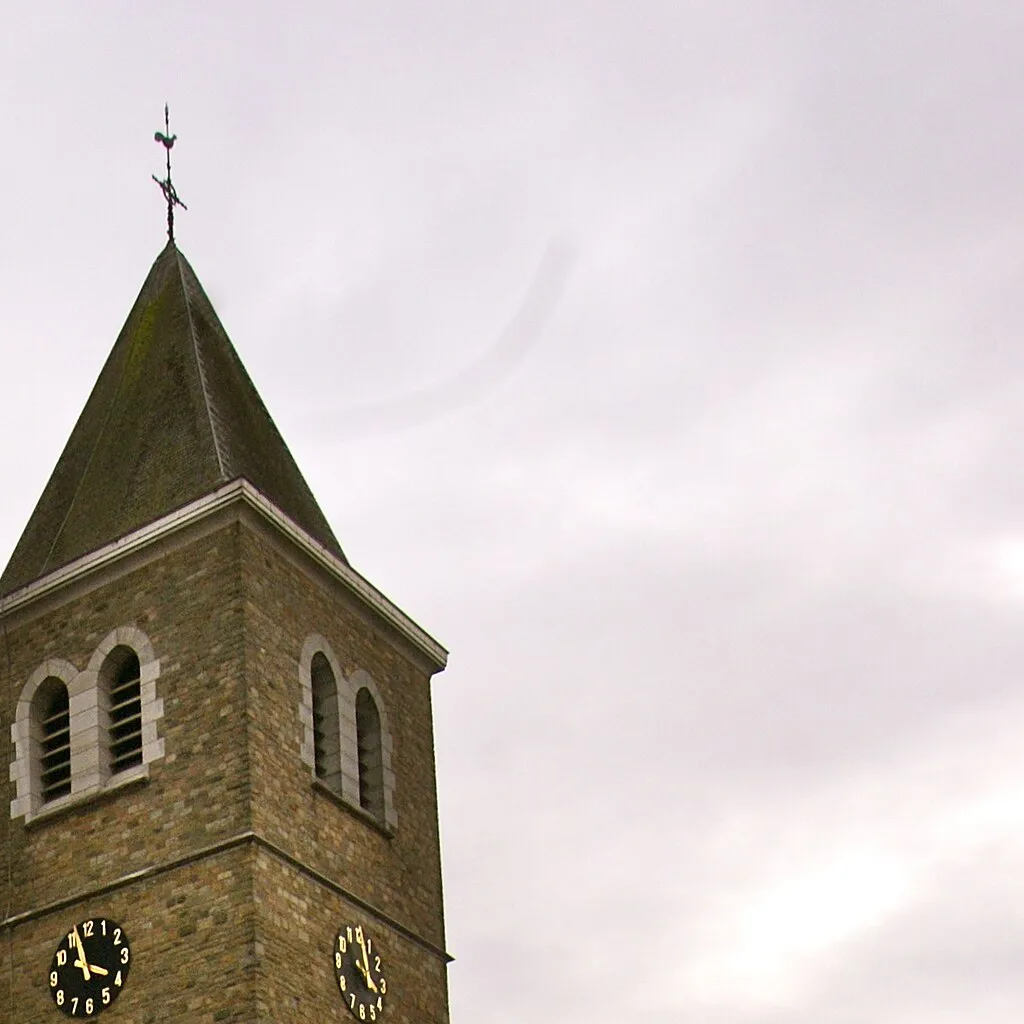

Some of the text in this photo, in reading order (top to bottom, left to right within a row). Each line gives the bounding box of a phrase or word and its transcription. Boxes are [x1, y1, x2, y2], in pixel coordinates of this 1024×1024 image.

[83, 920, 94, 937] 12
[101, 920, 106, 936] 1
[113, 928, 121, 946] 2
[339, 936, 346, 953] 10
[367, 939, 372, 954] 1
[56, 950, 67, 966] 10
[120, 948, 128, 964] 3
[375, 956, 381, 972] 2
[50, 972, 58, 987] 9
[114, 970, 122, 986] 4
[380, 978, 386, 994] 3
[56, 990, 64, 1005] 8
[102, 988, 110, 1004] 5
[350, 993, 356, 1008] 7
[377, 996, 382, 1012] 4
[71, 997, 78, 1014] 7
[86, 998, 94, 1014] 6
[370, 1005, 376, 1021] 5
